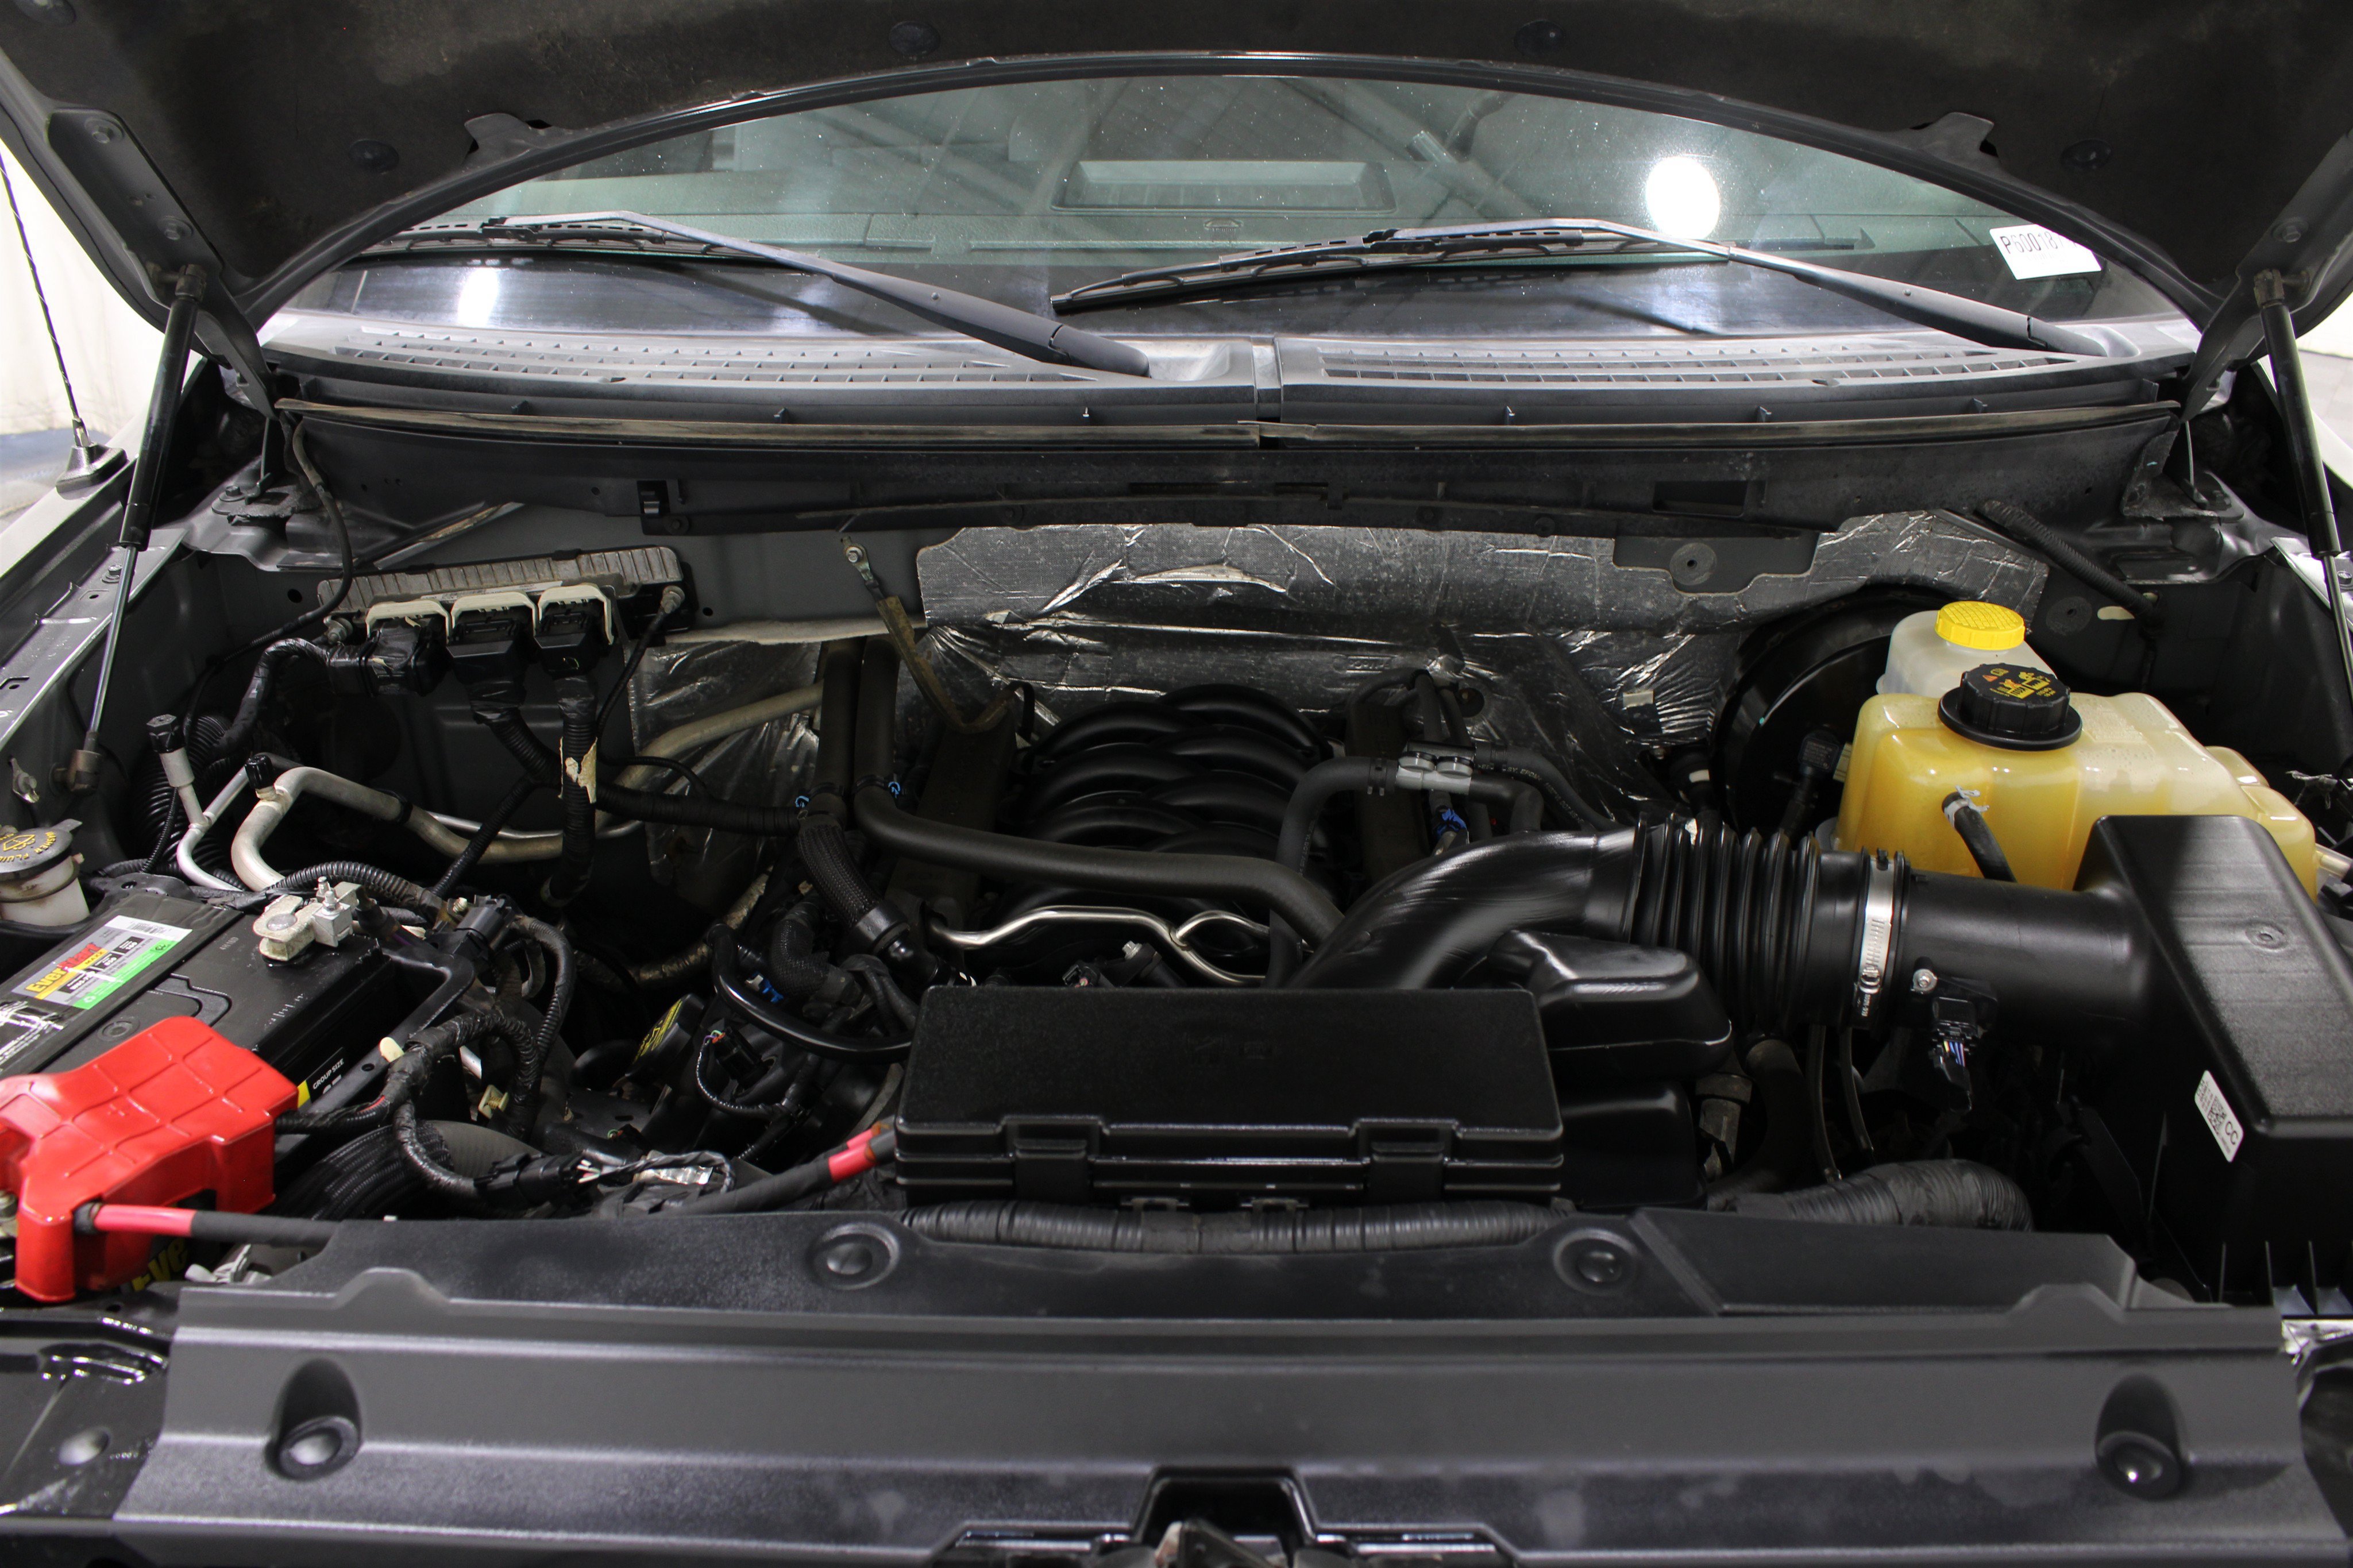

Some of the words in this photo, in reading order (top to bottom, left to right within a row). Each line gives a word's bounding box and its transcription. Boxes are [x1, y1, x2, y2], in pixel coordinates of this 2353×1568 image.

[34, 831, 56, 854] WASHER
[85, 951, 103, 964] MAXX
[313, 1069, 332, 1090] GROUP
[331, 1058, 345, 1072] SIZE
[2224, 1121, 2239, 1145] CC
